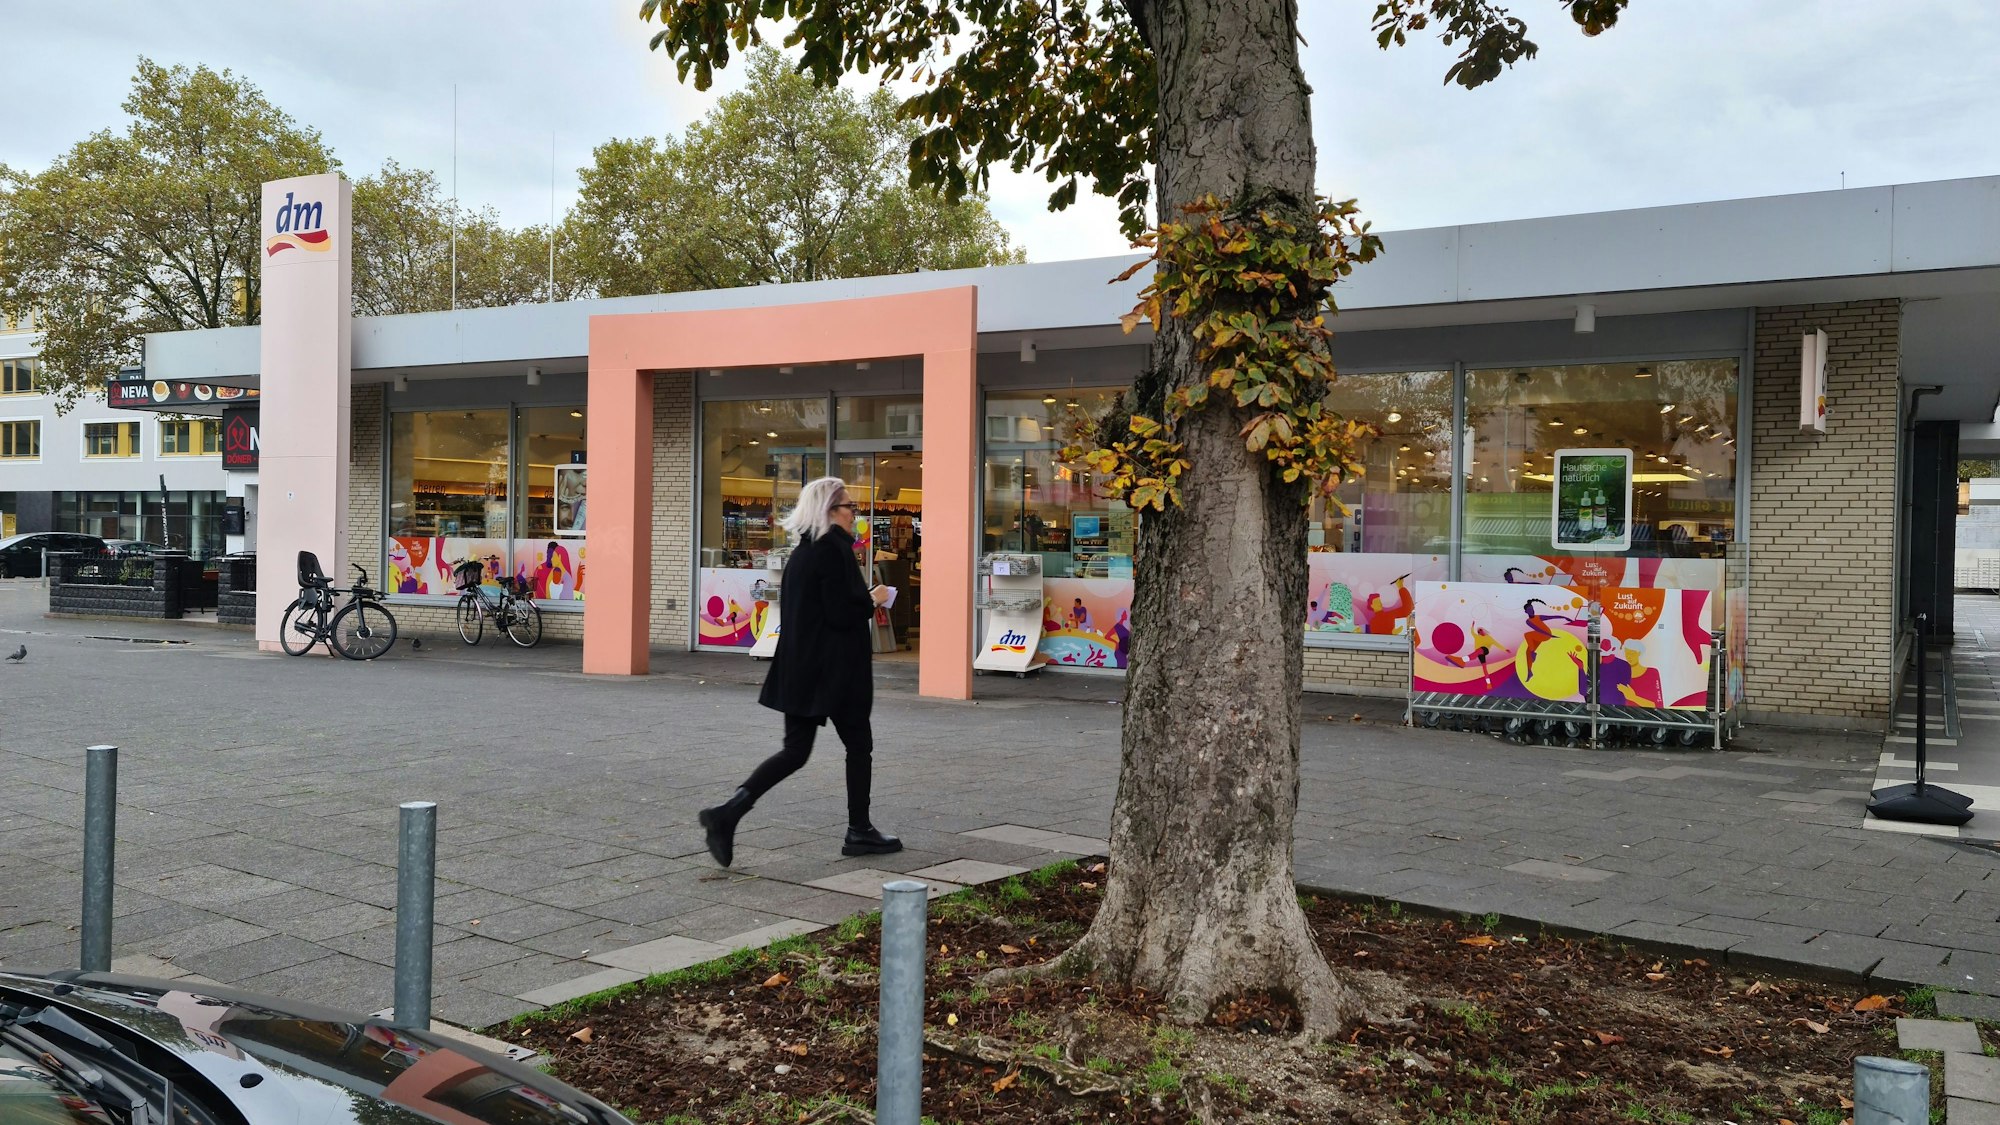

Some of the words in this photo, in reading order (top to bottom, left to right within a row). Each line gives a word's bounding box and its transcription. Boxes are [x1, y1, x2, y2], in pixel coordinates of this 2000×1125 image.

[276, 192, 323, 233] dm
[121, 385, 148, 399] NEVA
[226, 453, 252, 464] DÖNER
[575, 453, 580, 461] 1
[1562, 463, 1607, 472] Hautsache
[1562, 473, 1600, 482] natürlich
[1613, 602, 1644, 610] Zukunft
[1000, 630, 1027, 645] dm
